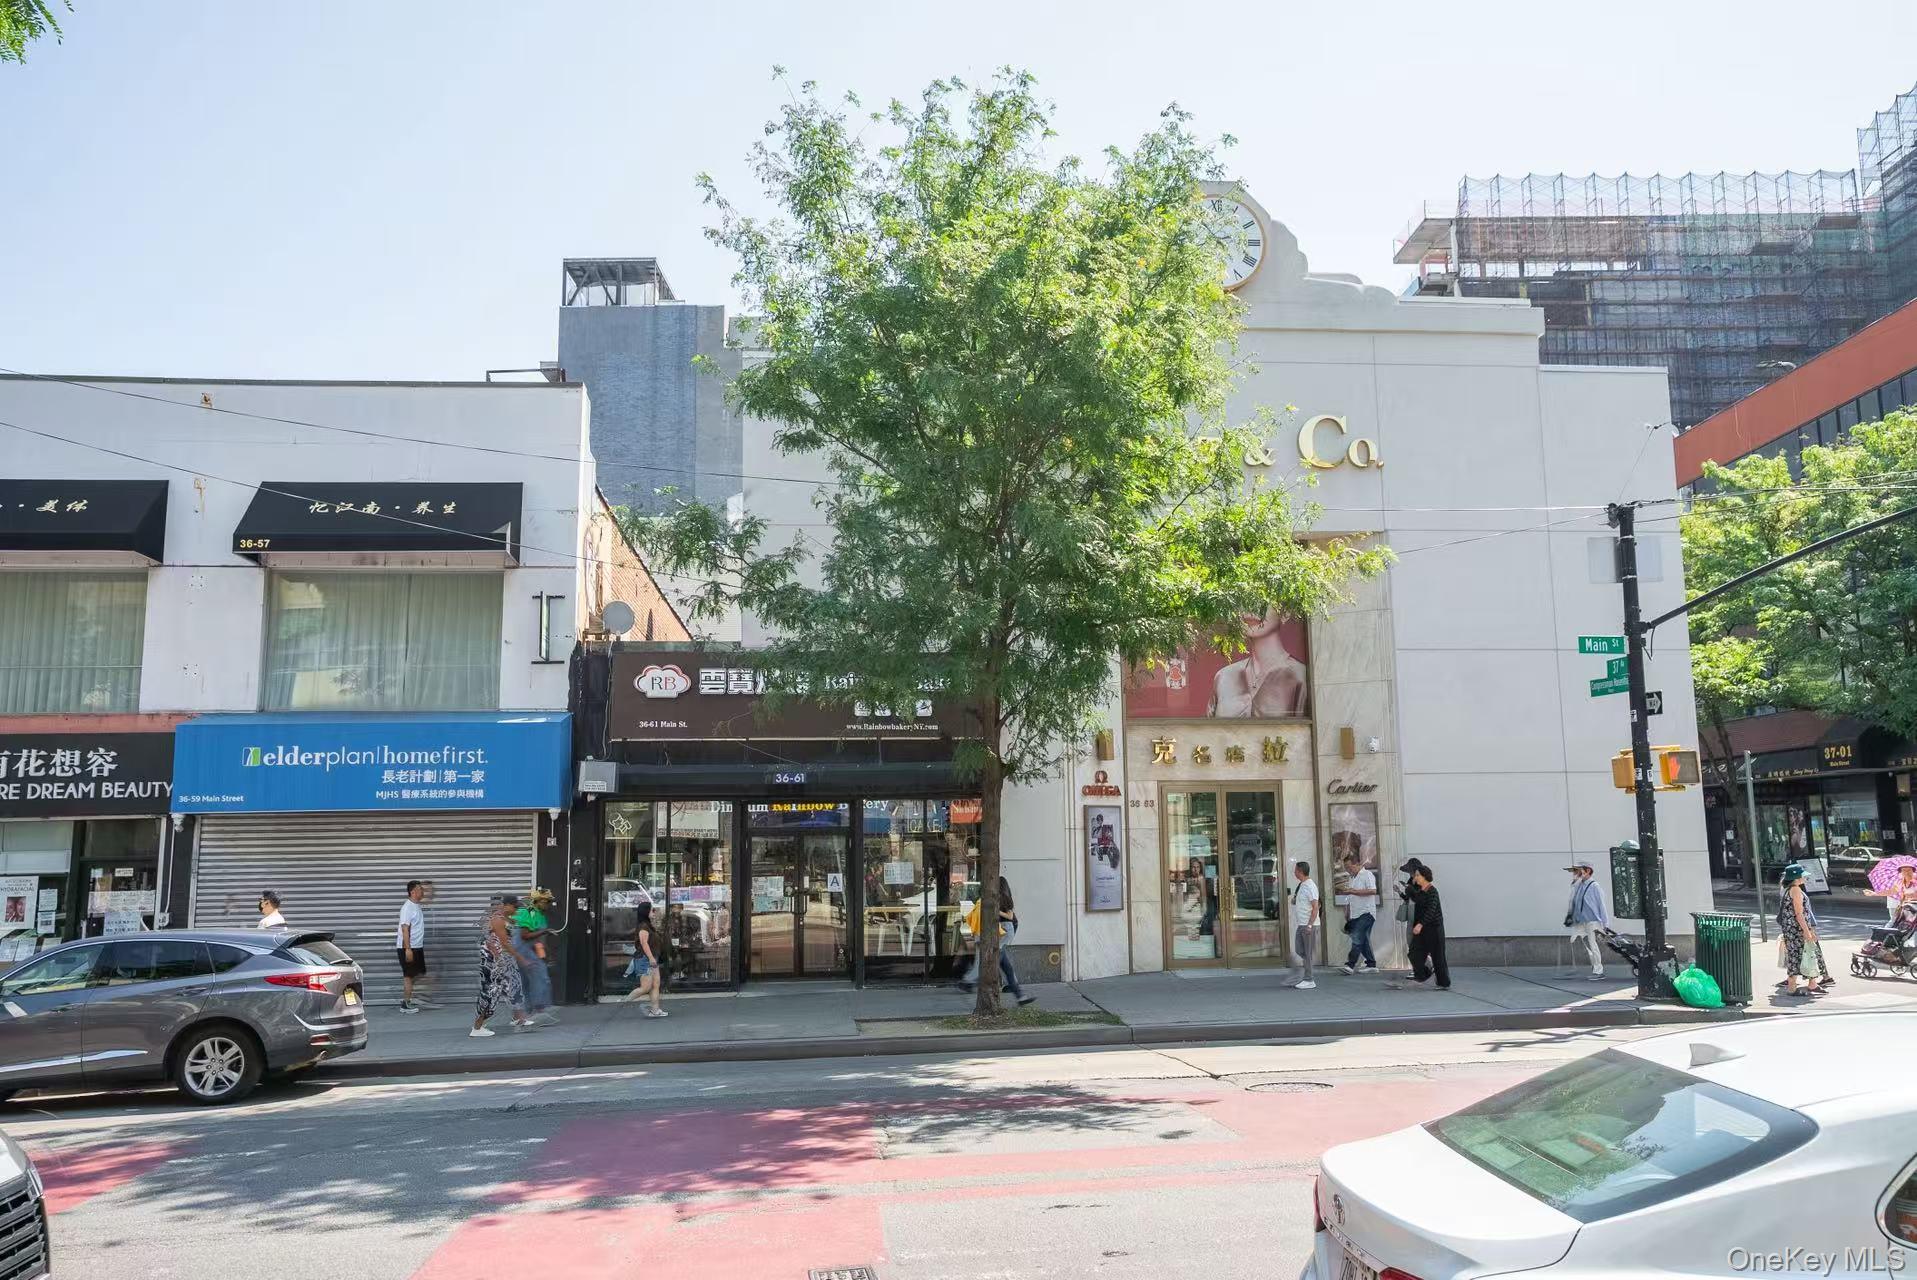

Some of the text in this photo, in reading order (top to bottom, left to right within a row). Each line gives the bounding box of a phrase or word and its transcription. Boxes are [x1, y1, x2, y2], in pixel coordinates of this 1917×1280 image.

[1298, 414, 1385, 469] Co.
[239, 538, 270, 549] 36-57
[1585, 638, 1608, 652] Main
[1612, 661, 1619, 674] 37
[651, 676, 677, 691] RB
[639, 720, 688, 729] 36-61 Main St.
[775, 773, 805, 783] 36-61
[26, 782, 96, 799] DREAM
[101, 781, 173, 798] BEAUTY
[1327, 779, 1378, 795] Cartier
[178, 795, 201, 803] 36-59
[375, 789, 399, 800] MJHS
[748, 803, 769, 812] um
